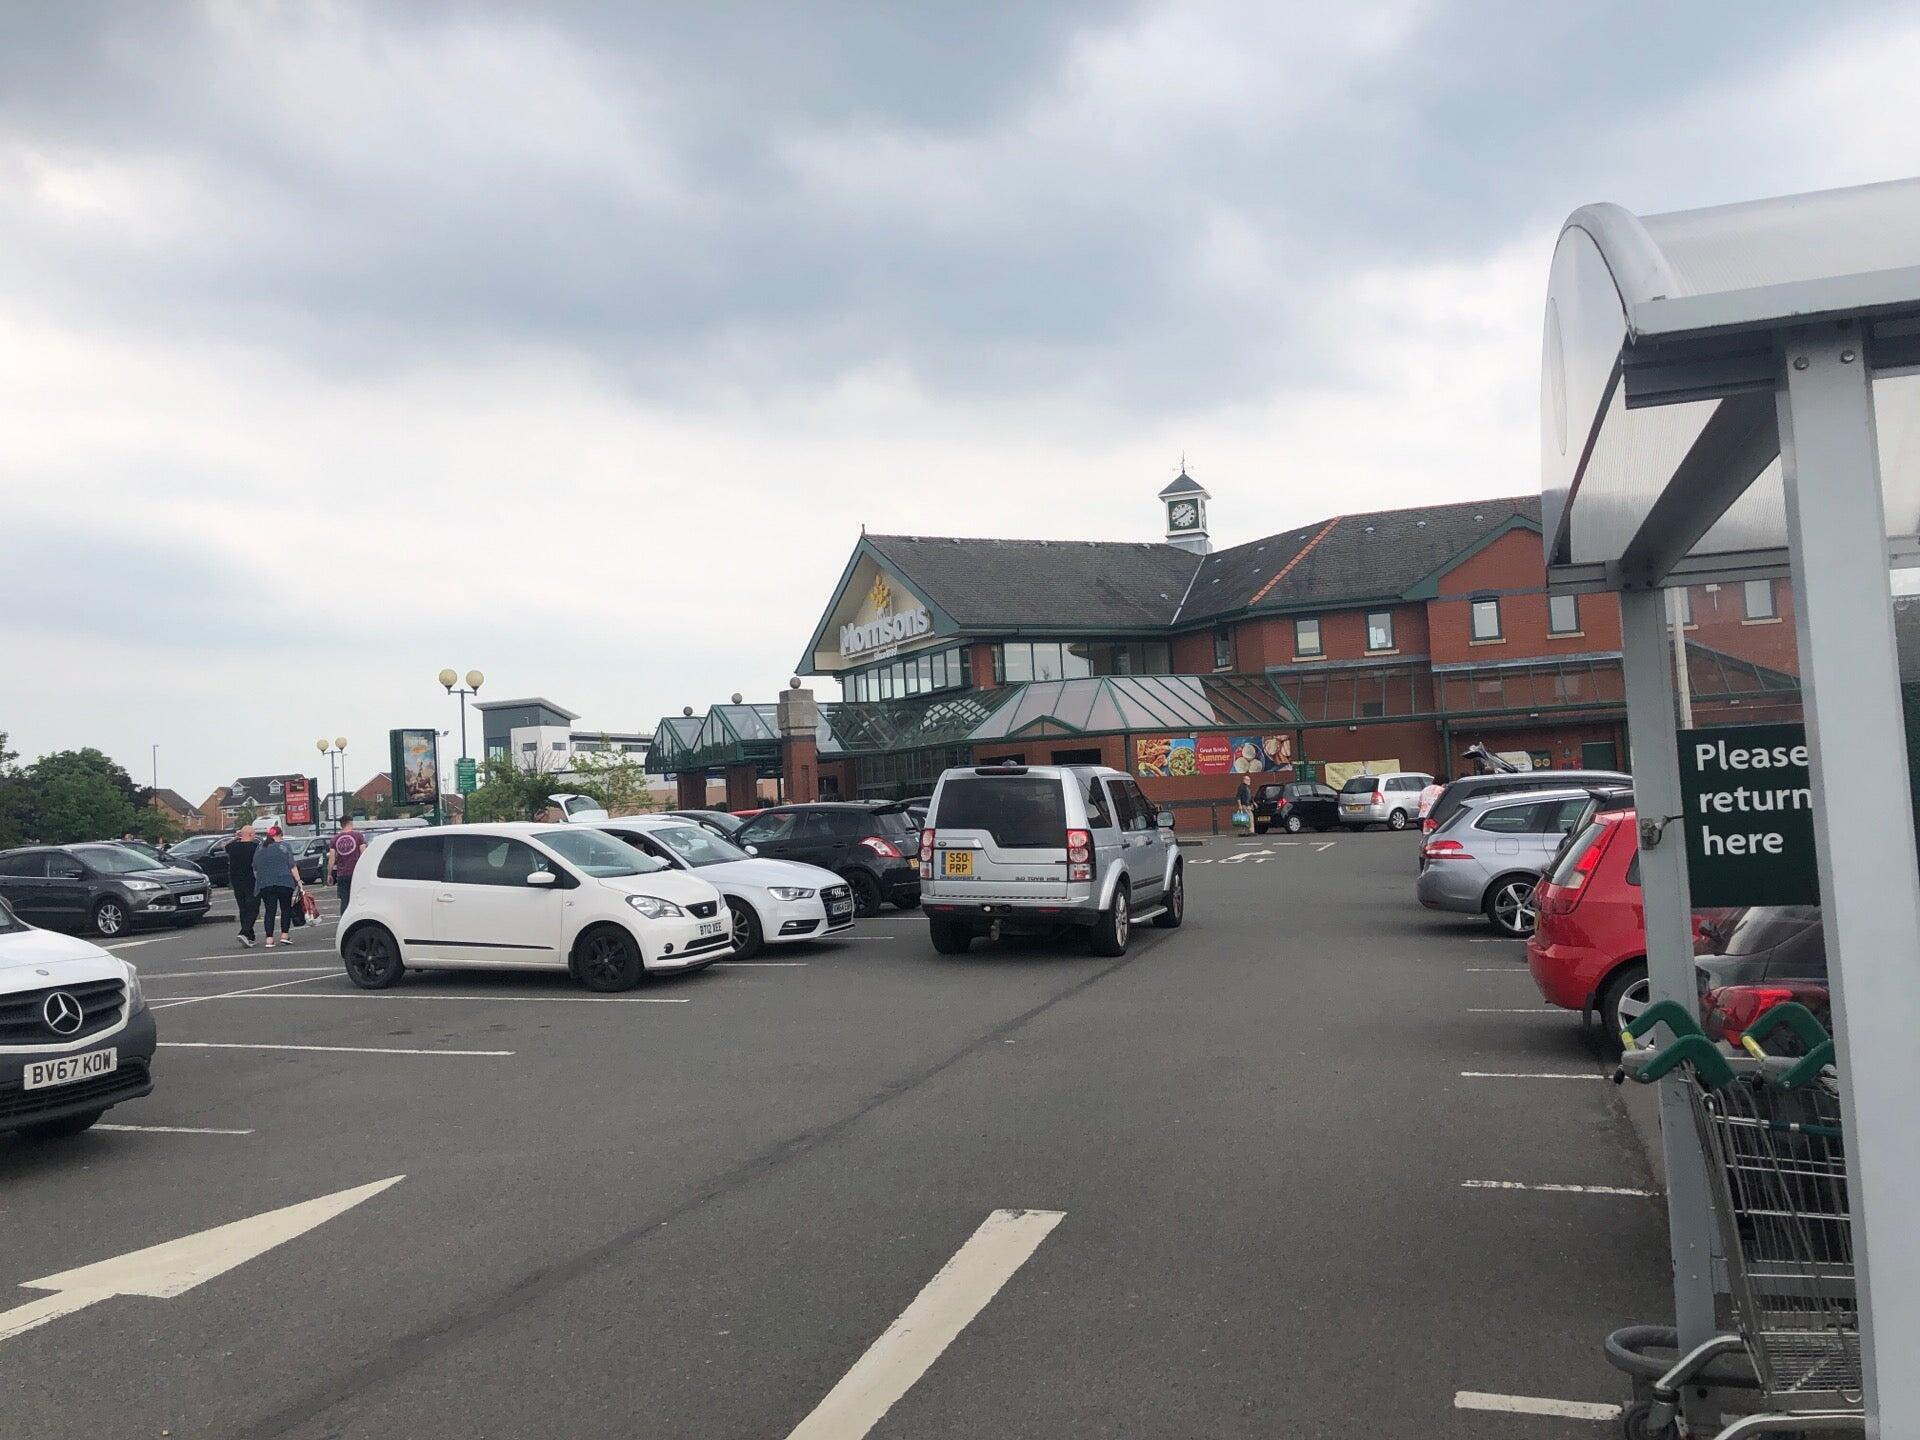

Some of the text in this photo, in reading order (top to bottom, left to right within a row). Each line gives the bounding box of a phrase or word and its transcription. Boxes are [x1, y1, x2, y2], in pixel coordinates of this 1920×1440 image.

[840, 605, 929, 657] Morrisons
[1198, 753, 1230, 762] Summer
[1695, 740, 1809, 771] Please
[1699, 786, 1813, 813] return
[1702, 825, 1784, 856] here
[949, 863, 969, 873] PRP
[32, 1051, 111, 1085] BV67 KOW
